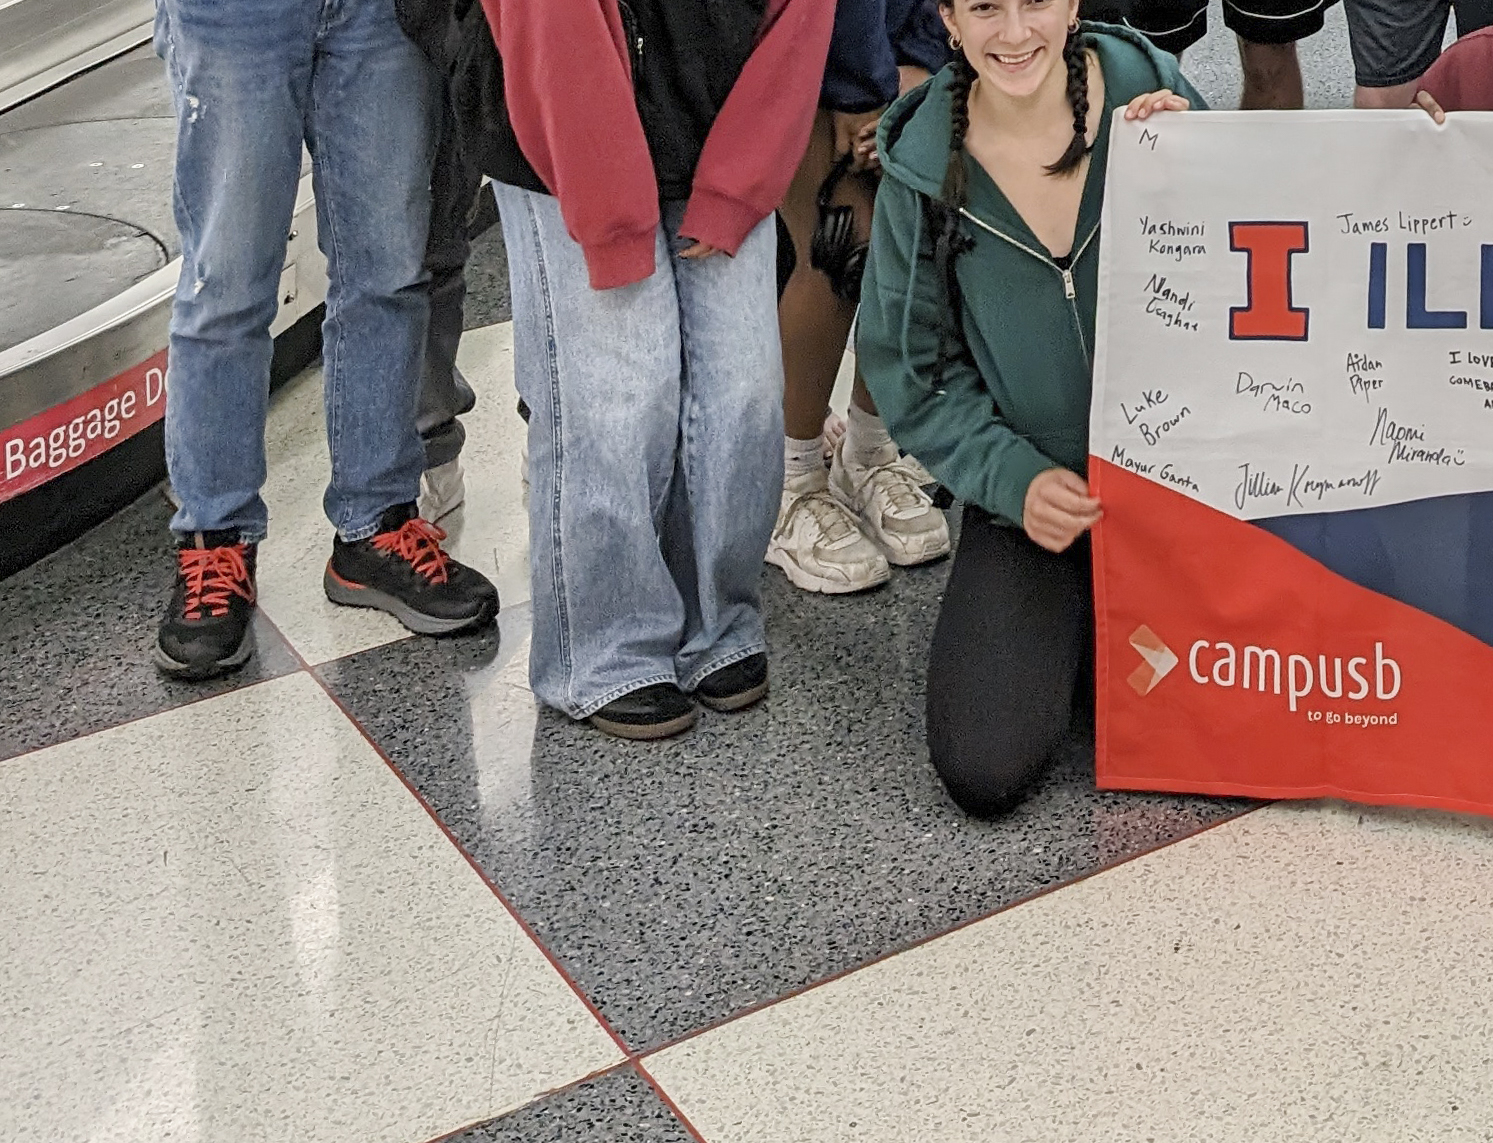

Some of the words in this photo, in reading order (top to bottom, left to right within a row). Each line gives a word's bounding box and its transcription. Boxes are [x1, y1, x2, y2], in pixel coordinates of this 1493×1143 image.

[1336, 212, 1390, 235] James
[1399, 210, 1458, 235] Lippert
[1228, 221, 1310, 343] I
[1346, 352, 1383, 374] Aidan
[1449, 350, 1461, 364] I
[1349, 373, 1384, 404] Piper
[5, 389, 137, 480] Baggage
[1138, 405, 1191, 446] Brown
[1110, 444, 1155, 475] Mayur
[1188, 639, 1403, 713] campusb
[1307, 709, 1323, 722] to
[1326, 710, 1342, 725] go
[1344, 711, 1399, 729] beyond
